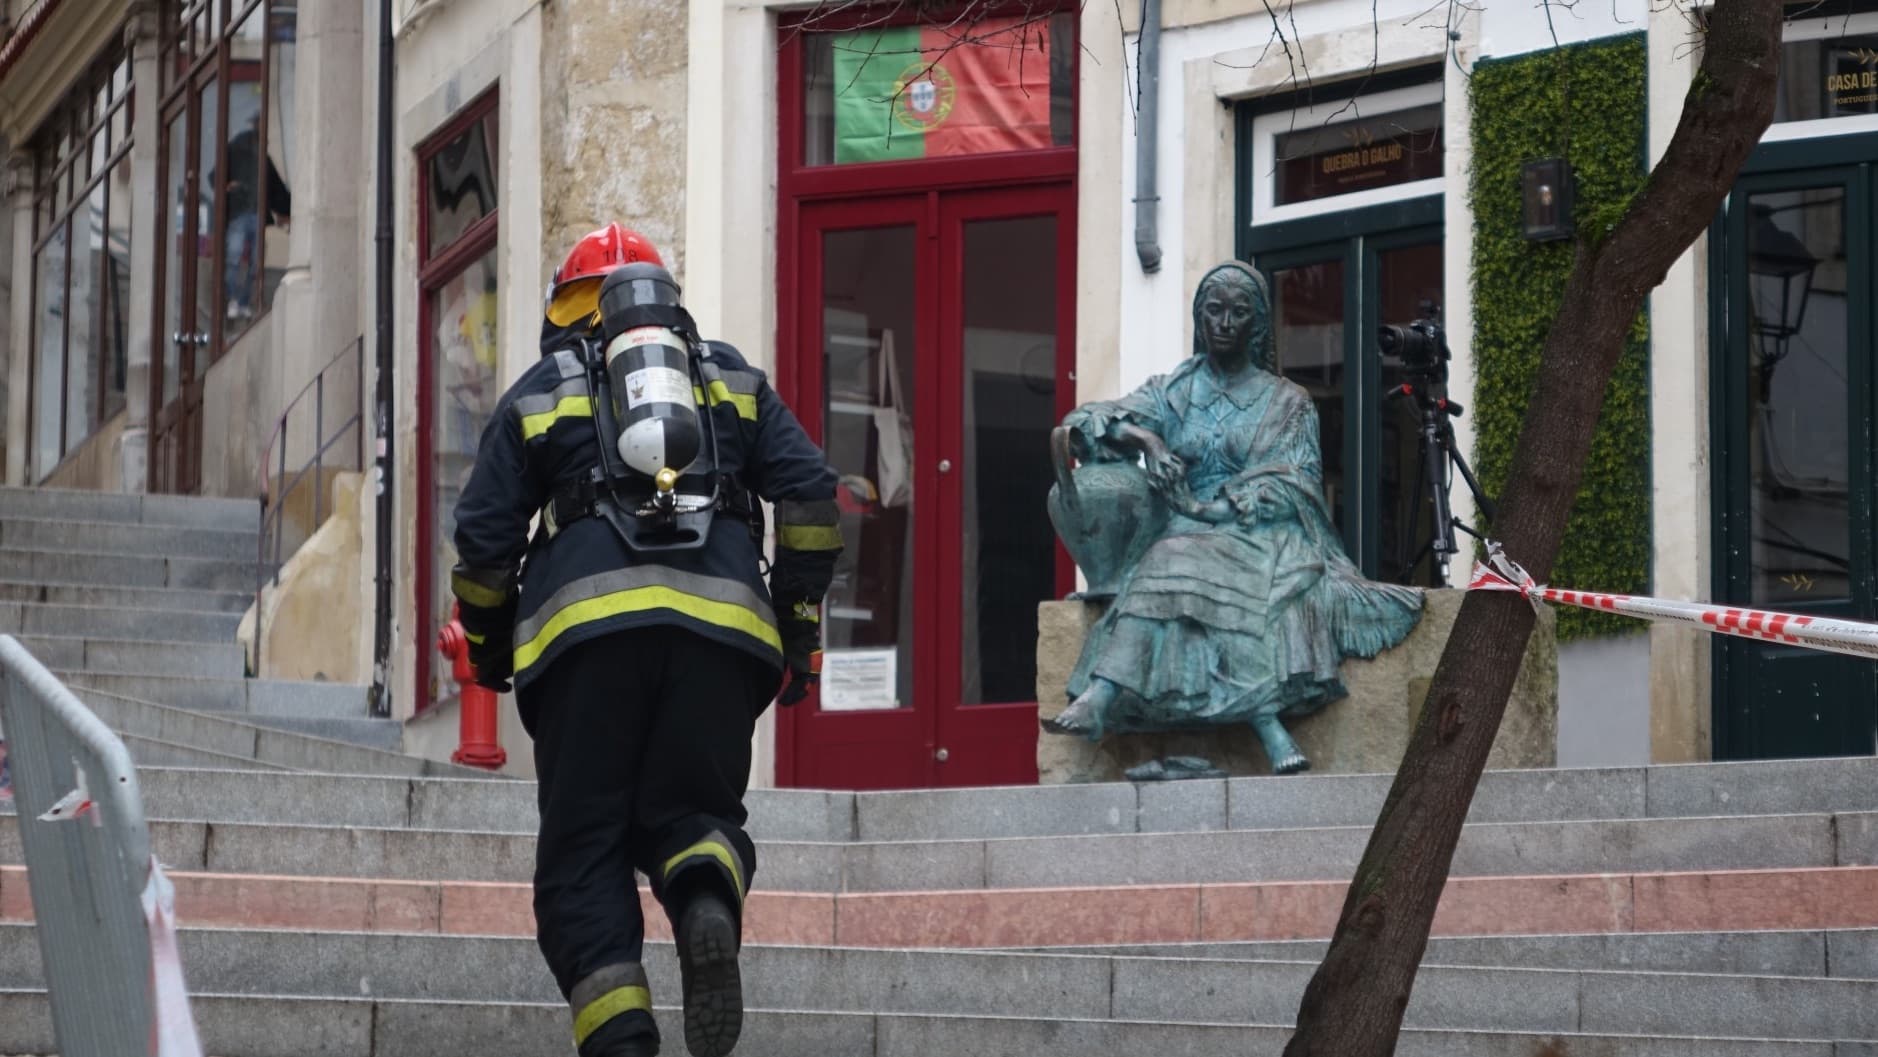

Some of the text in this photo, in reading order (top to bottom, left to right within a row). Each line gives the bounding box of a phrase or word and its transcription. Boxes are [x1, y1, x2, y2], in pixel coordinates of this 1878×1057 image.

[1828, 71, 1878, 92] CASA DE
[1323, 143, 1402, 174] QUEBRA O GALHO
